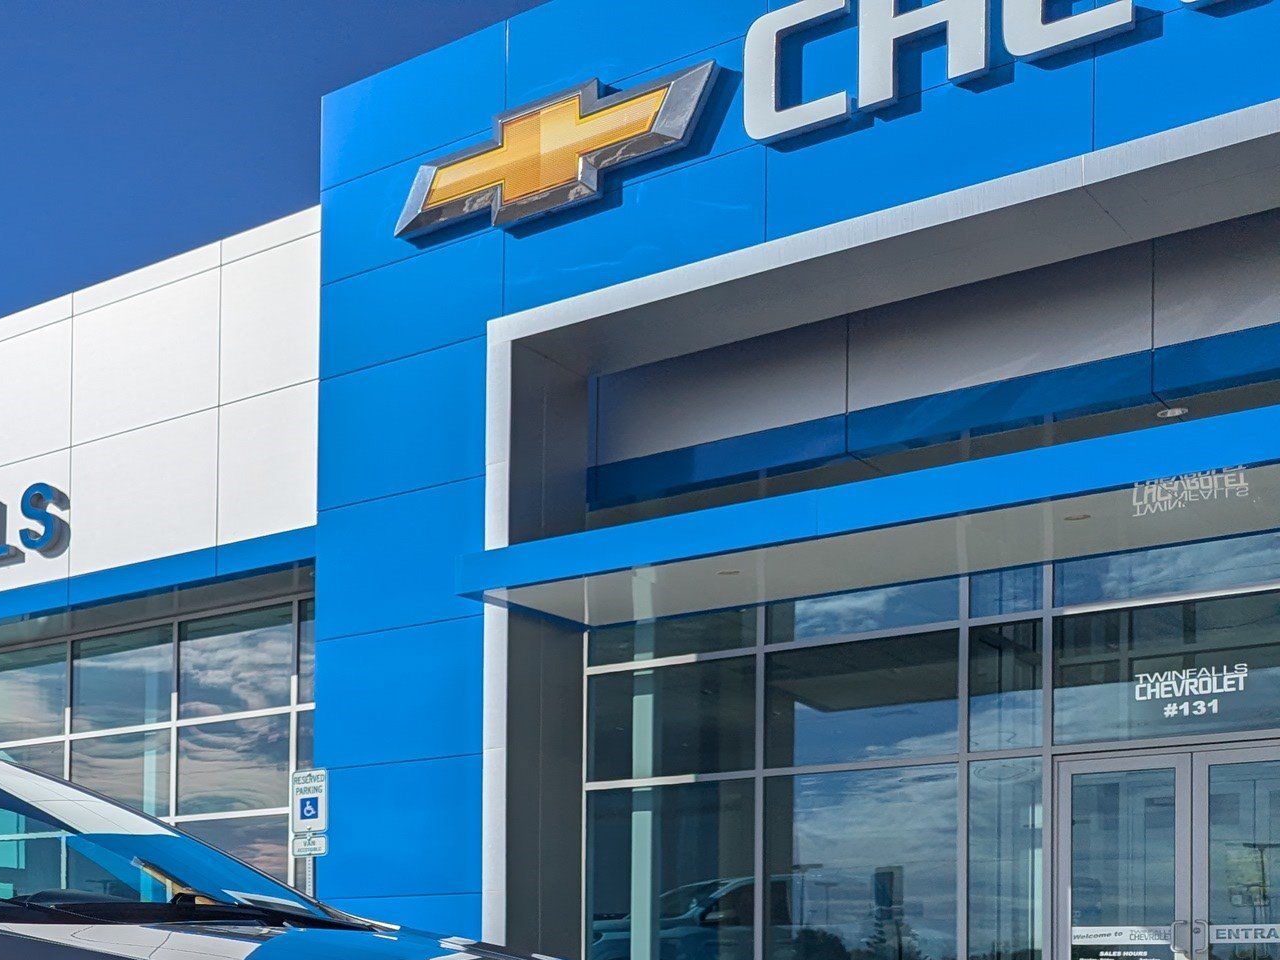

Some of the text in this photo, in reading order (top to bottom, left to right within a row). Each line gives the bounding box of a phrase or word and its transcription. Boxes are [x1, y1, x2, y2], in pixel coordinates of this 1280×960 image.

[743, 0, 1242, 144] CH
[1134, 663, 1248, 684] TWINFALLS
[1135, 673, 1248, 700] CHEVROLET
[1163, 699, 1218, 718] #131
[293, 774, 325, 785] RESERVED
[295, 785, 323, 795] PARKING
[1215, 928, 1279, 940] ENTRA
